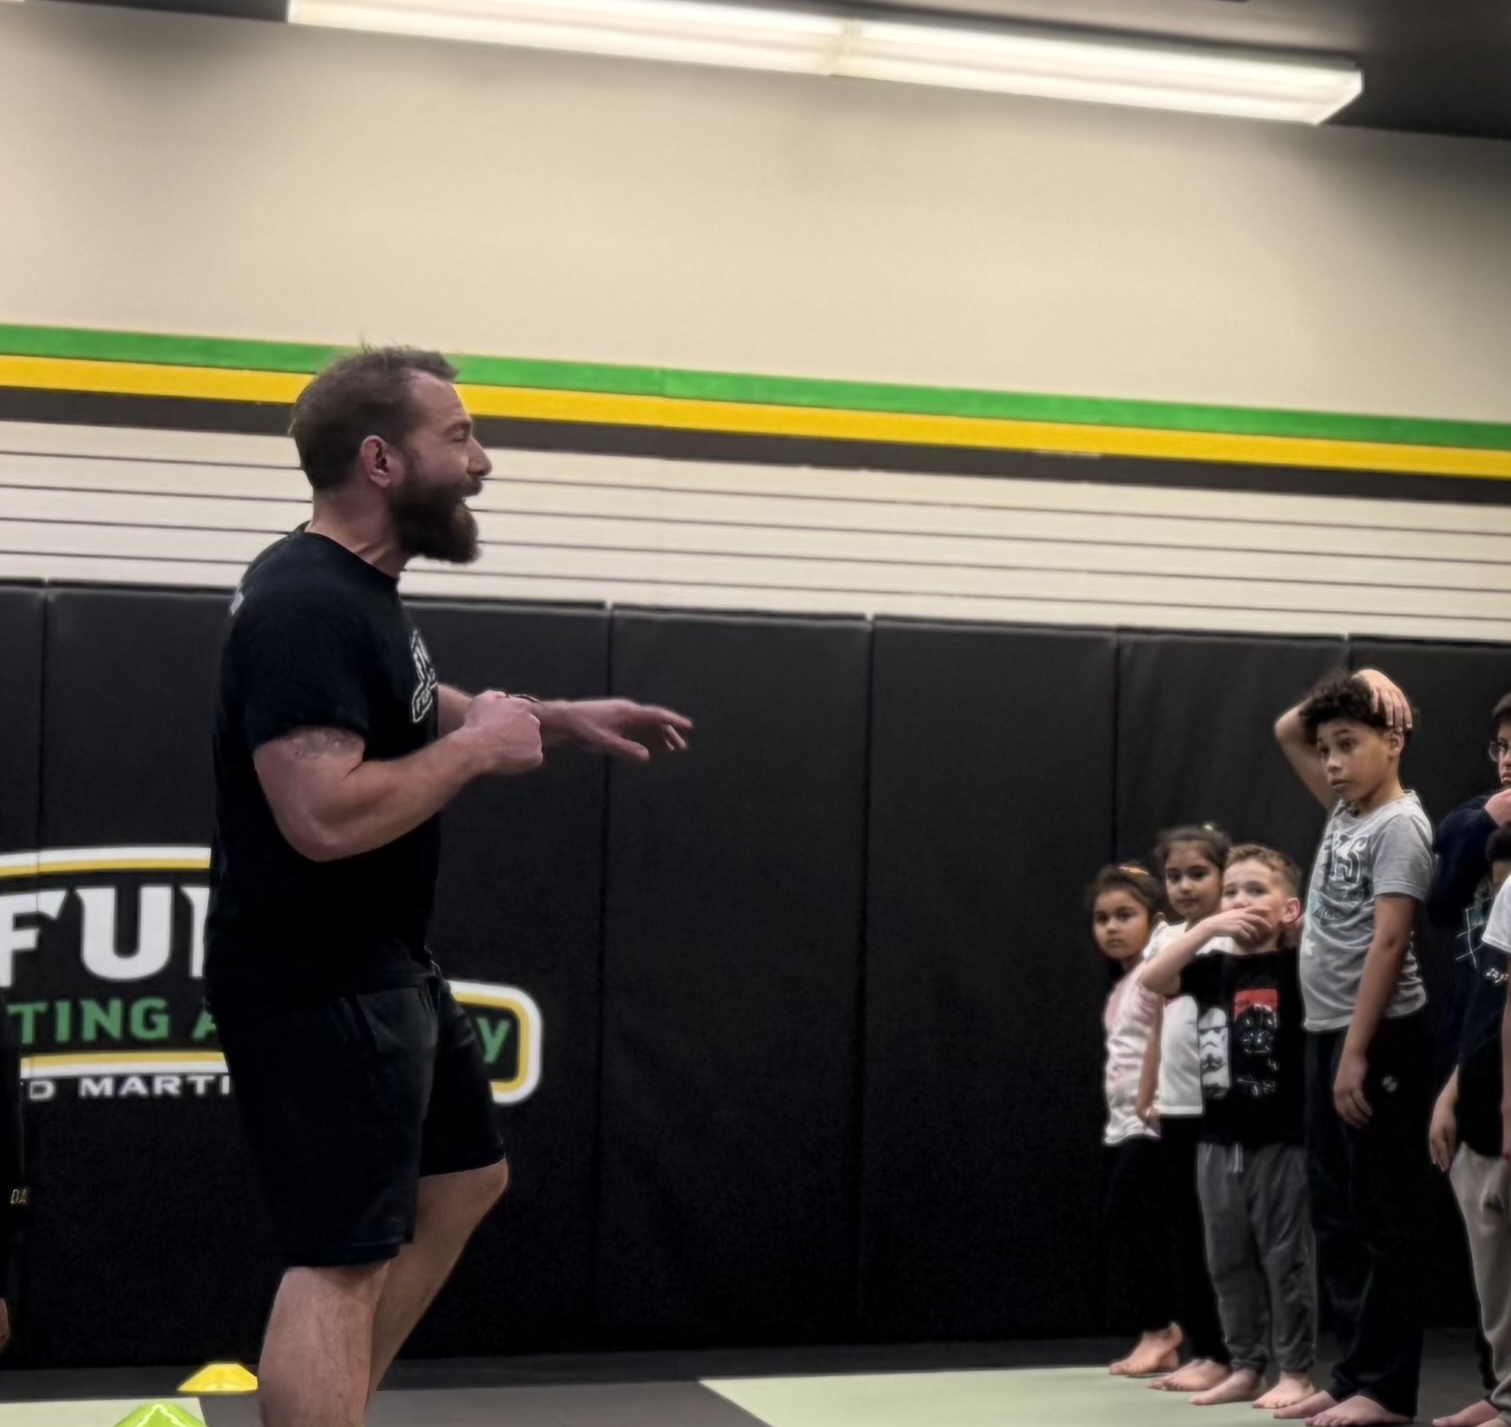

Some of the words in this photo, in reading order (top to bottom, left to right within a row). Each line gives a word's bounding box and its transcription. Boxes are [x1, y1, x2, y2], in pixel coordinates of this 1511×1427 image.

[0, 885, 210, 988] FU
[6, 998, 170, 1045] TING
[78, 1075, 230, 1097] MARTI
